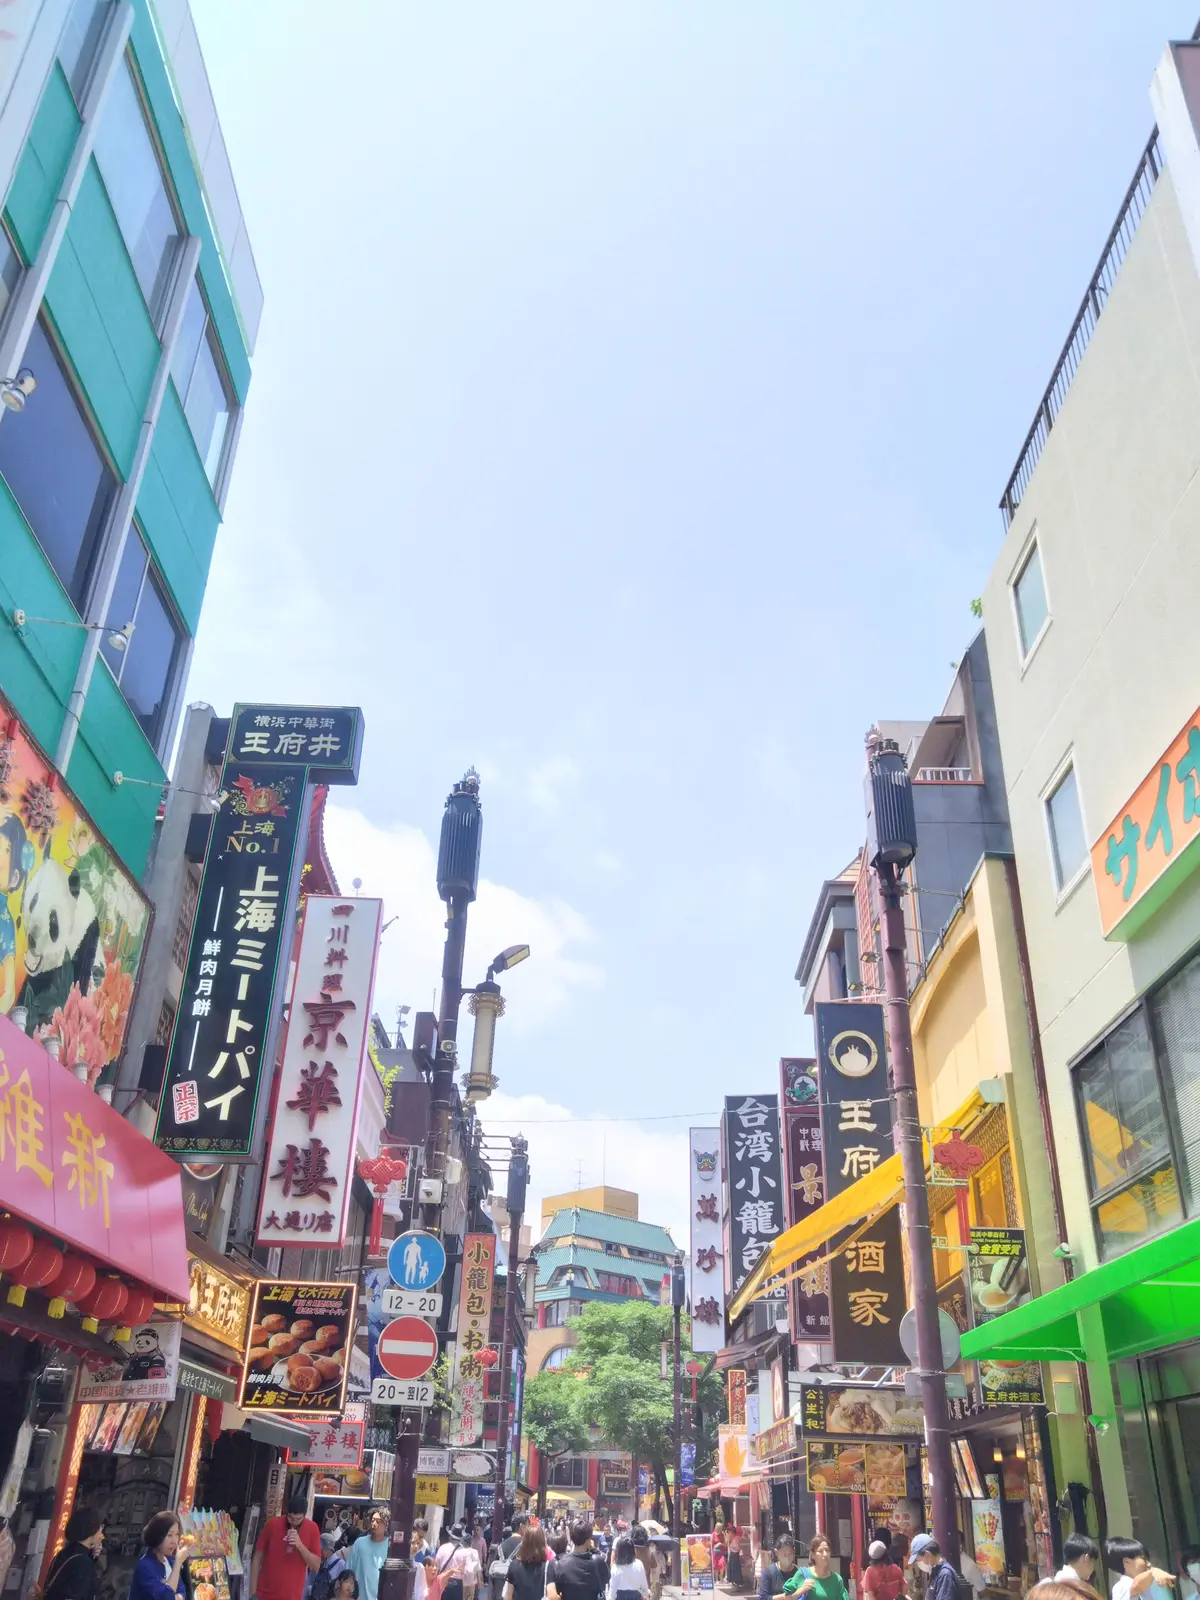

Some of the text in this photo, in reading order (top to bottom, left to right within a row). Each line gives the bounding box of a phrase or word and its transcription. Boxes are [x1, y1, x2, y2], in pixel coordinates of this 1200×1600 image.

[254, 714, 336, 730] 横浜中華街
[240, 731, 342, 757] 王府井
[233, 820, 275, 836] 上海
[203, 865, 280, 1121] 上海ミートパイ
[174, 1082, 197, 1122] 正宗
[263, 1210, 336, 1233] 大通り店
[837, 1099, 891, 1326] 王府酒家
[246, 1391, 337, 1407] 上海ミートパイ
